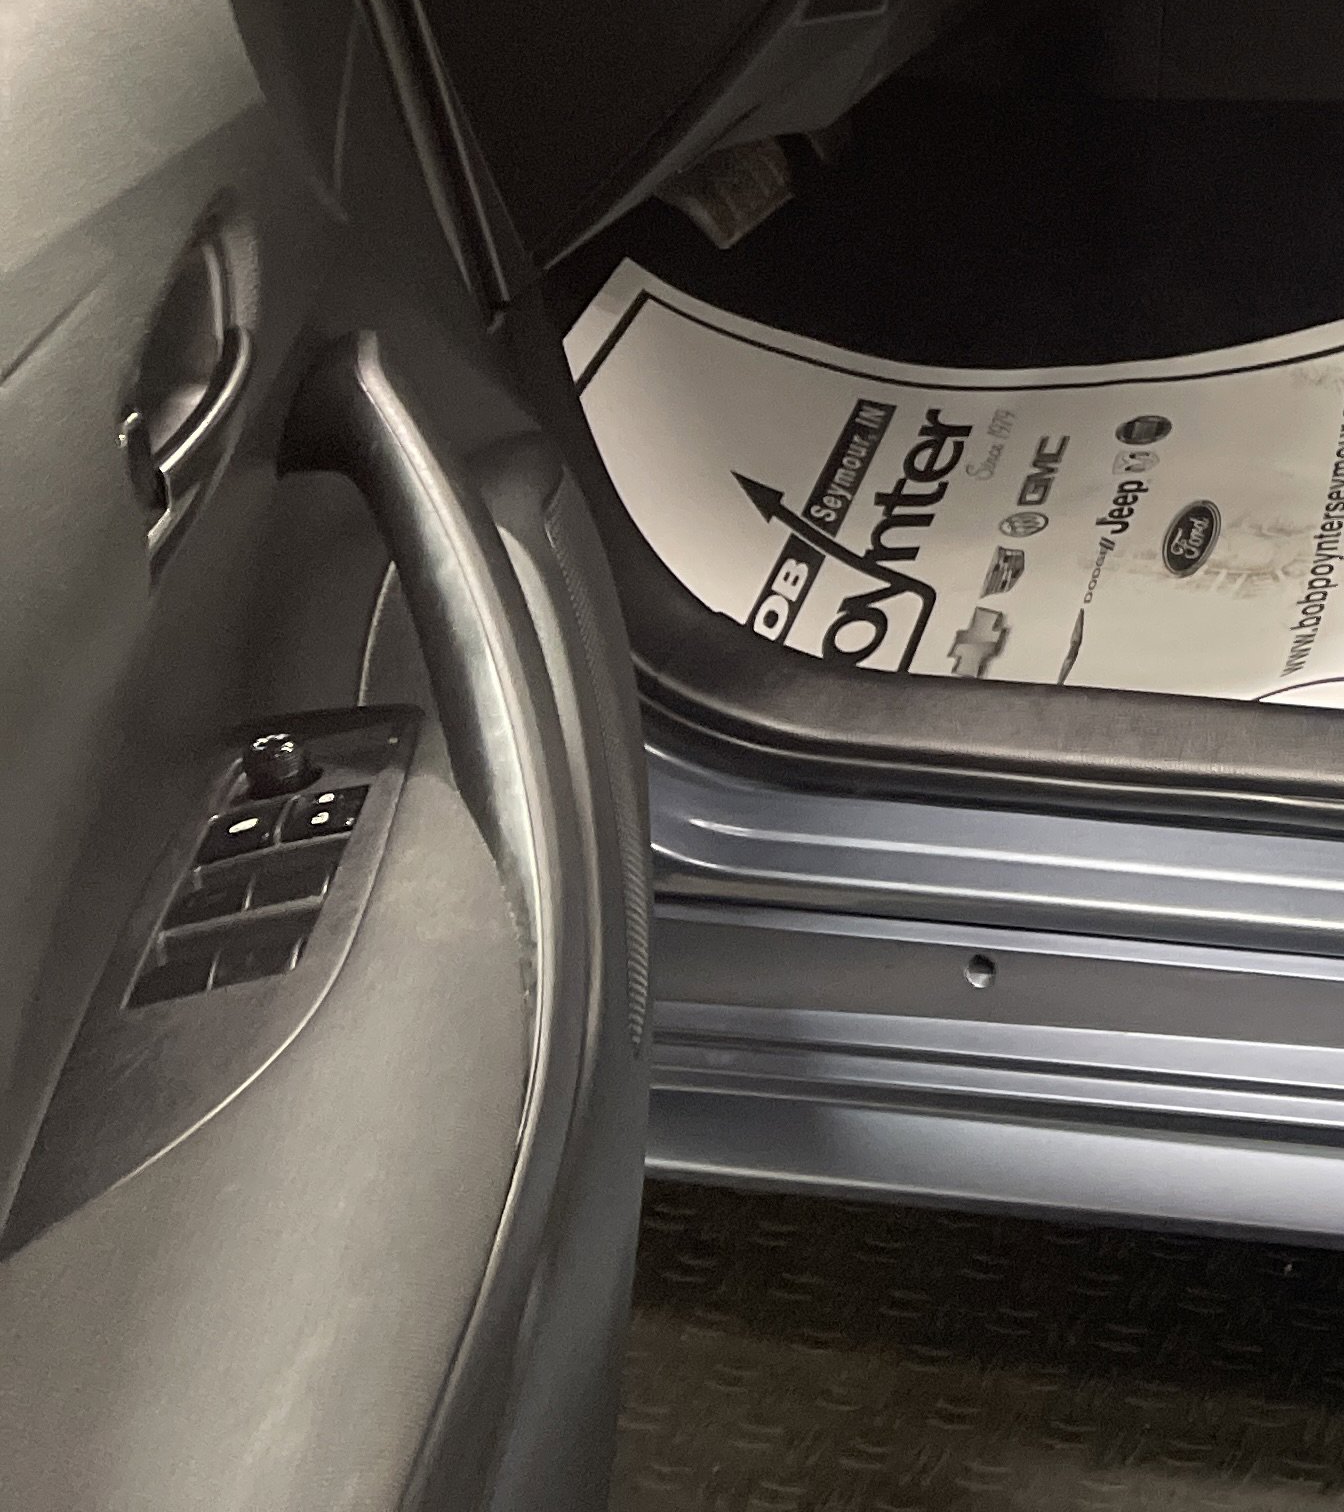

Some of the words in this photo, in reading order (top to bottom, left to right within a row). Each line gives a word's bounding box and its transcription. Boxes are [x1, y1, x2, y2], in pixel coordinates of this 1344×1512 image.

[855, 405, 886, 429] IN
[965, 443, 1004, 481] Since
[1017, 435, 1071, 506] GMC
[1096, 480, 1149, 534] Jeep
[822, 408, 973, 672] oynter
[1170, 516, 1209, 559] Ford
[752, 557, 809, 641] OB
